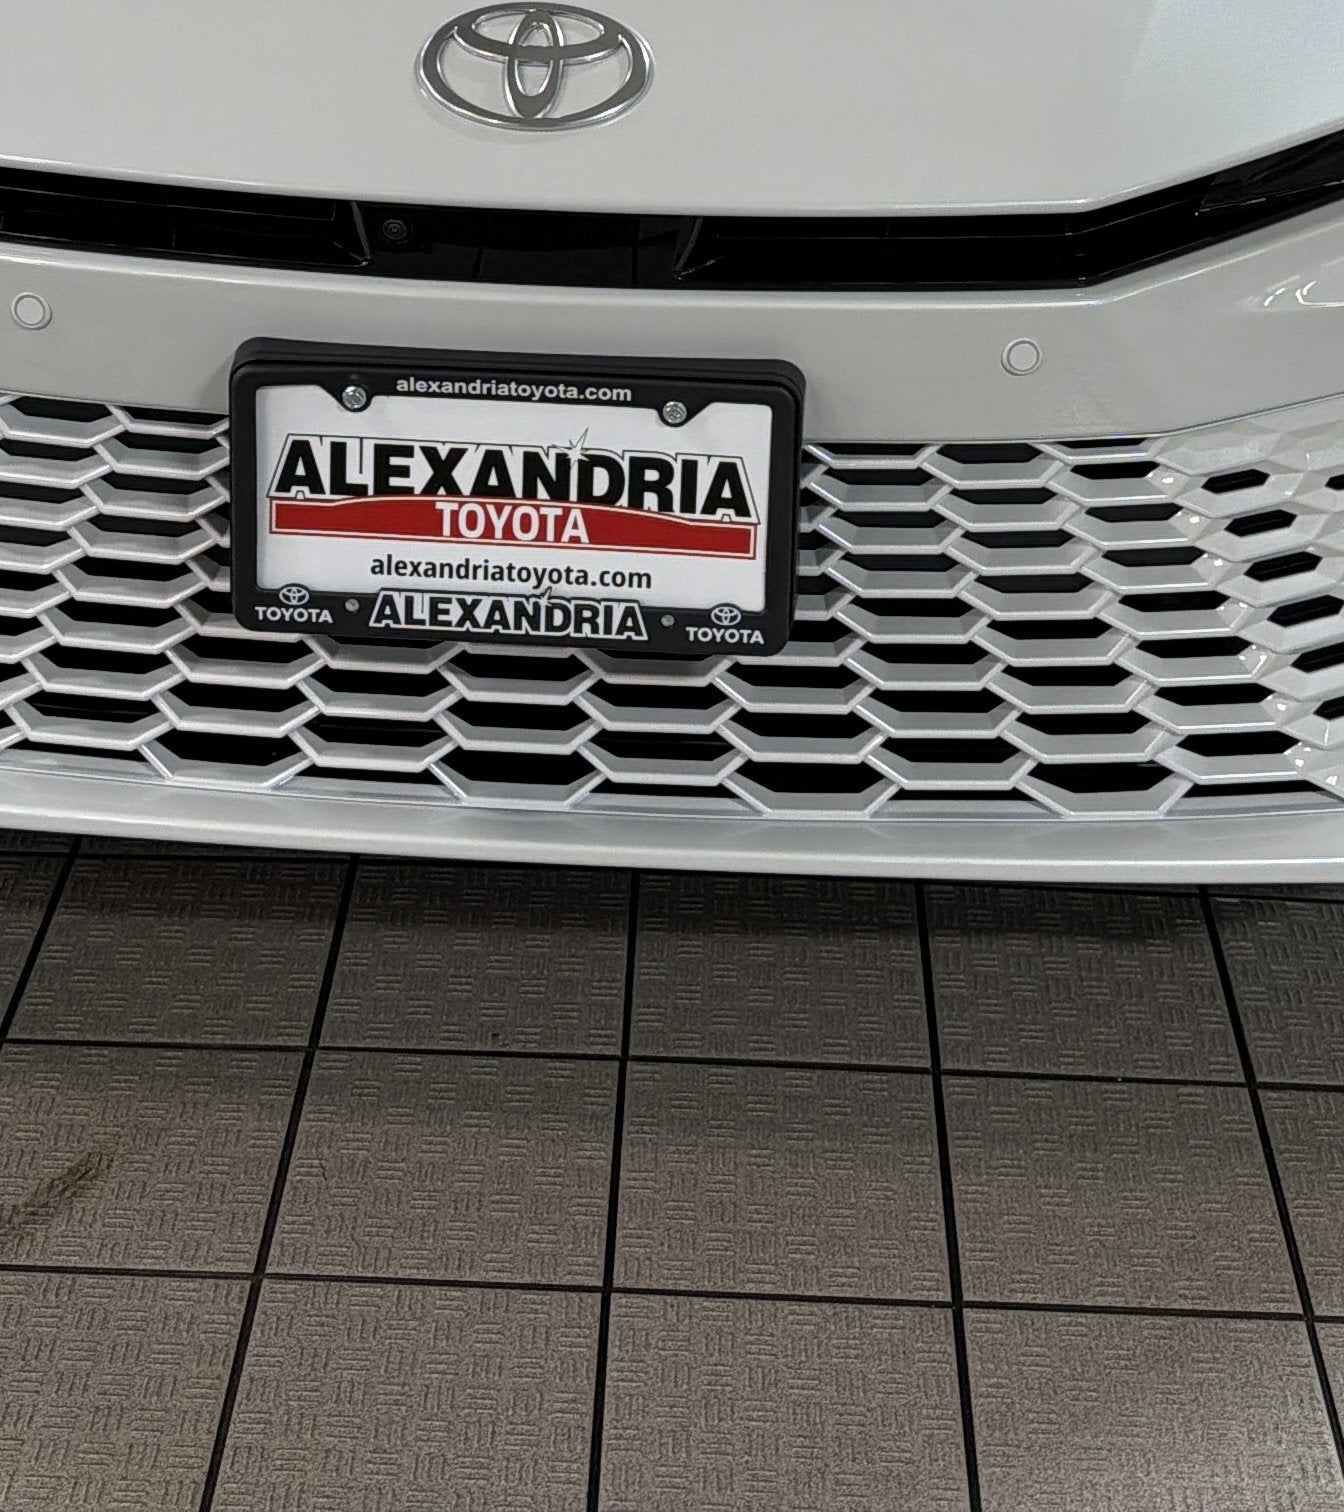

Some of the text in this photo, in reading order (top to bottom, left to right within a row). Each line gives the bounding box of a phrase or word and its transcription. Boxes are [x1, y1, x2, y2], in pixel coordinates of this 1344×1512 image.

[395, 375, 633, 403] alexandriatoyota.com
[270, 436, 757, 521] ALEXANDRIA
[435, 502, 590, 545] TOYOTA
[369, 554, 653, 591] alexandriatoyota.com
[255, 605, 334, 625] TOYOTA
[369, 590, 650, 641] ALEXANDRIA
[685, 626, 765, 646] TOYOTA
